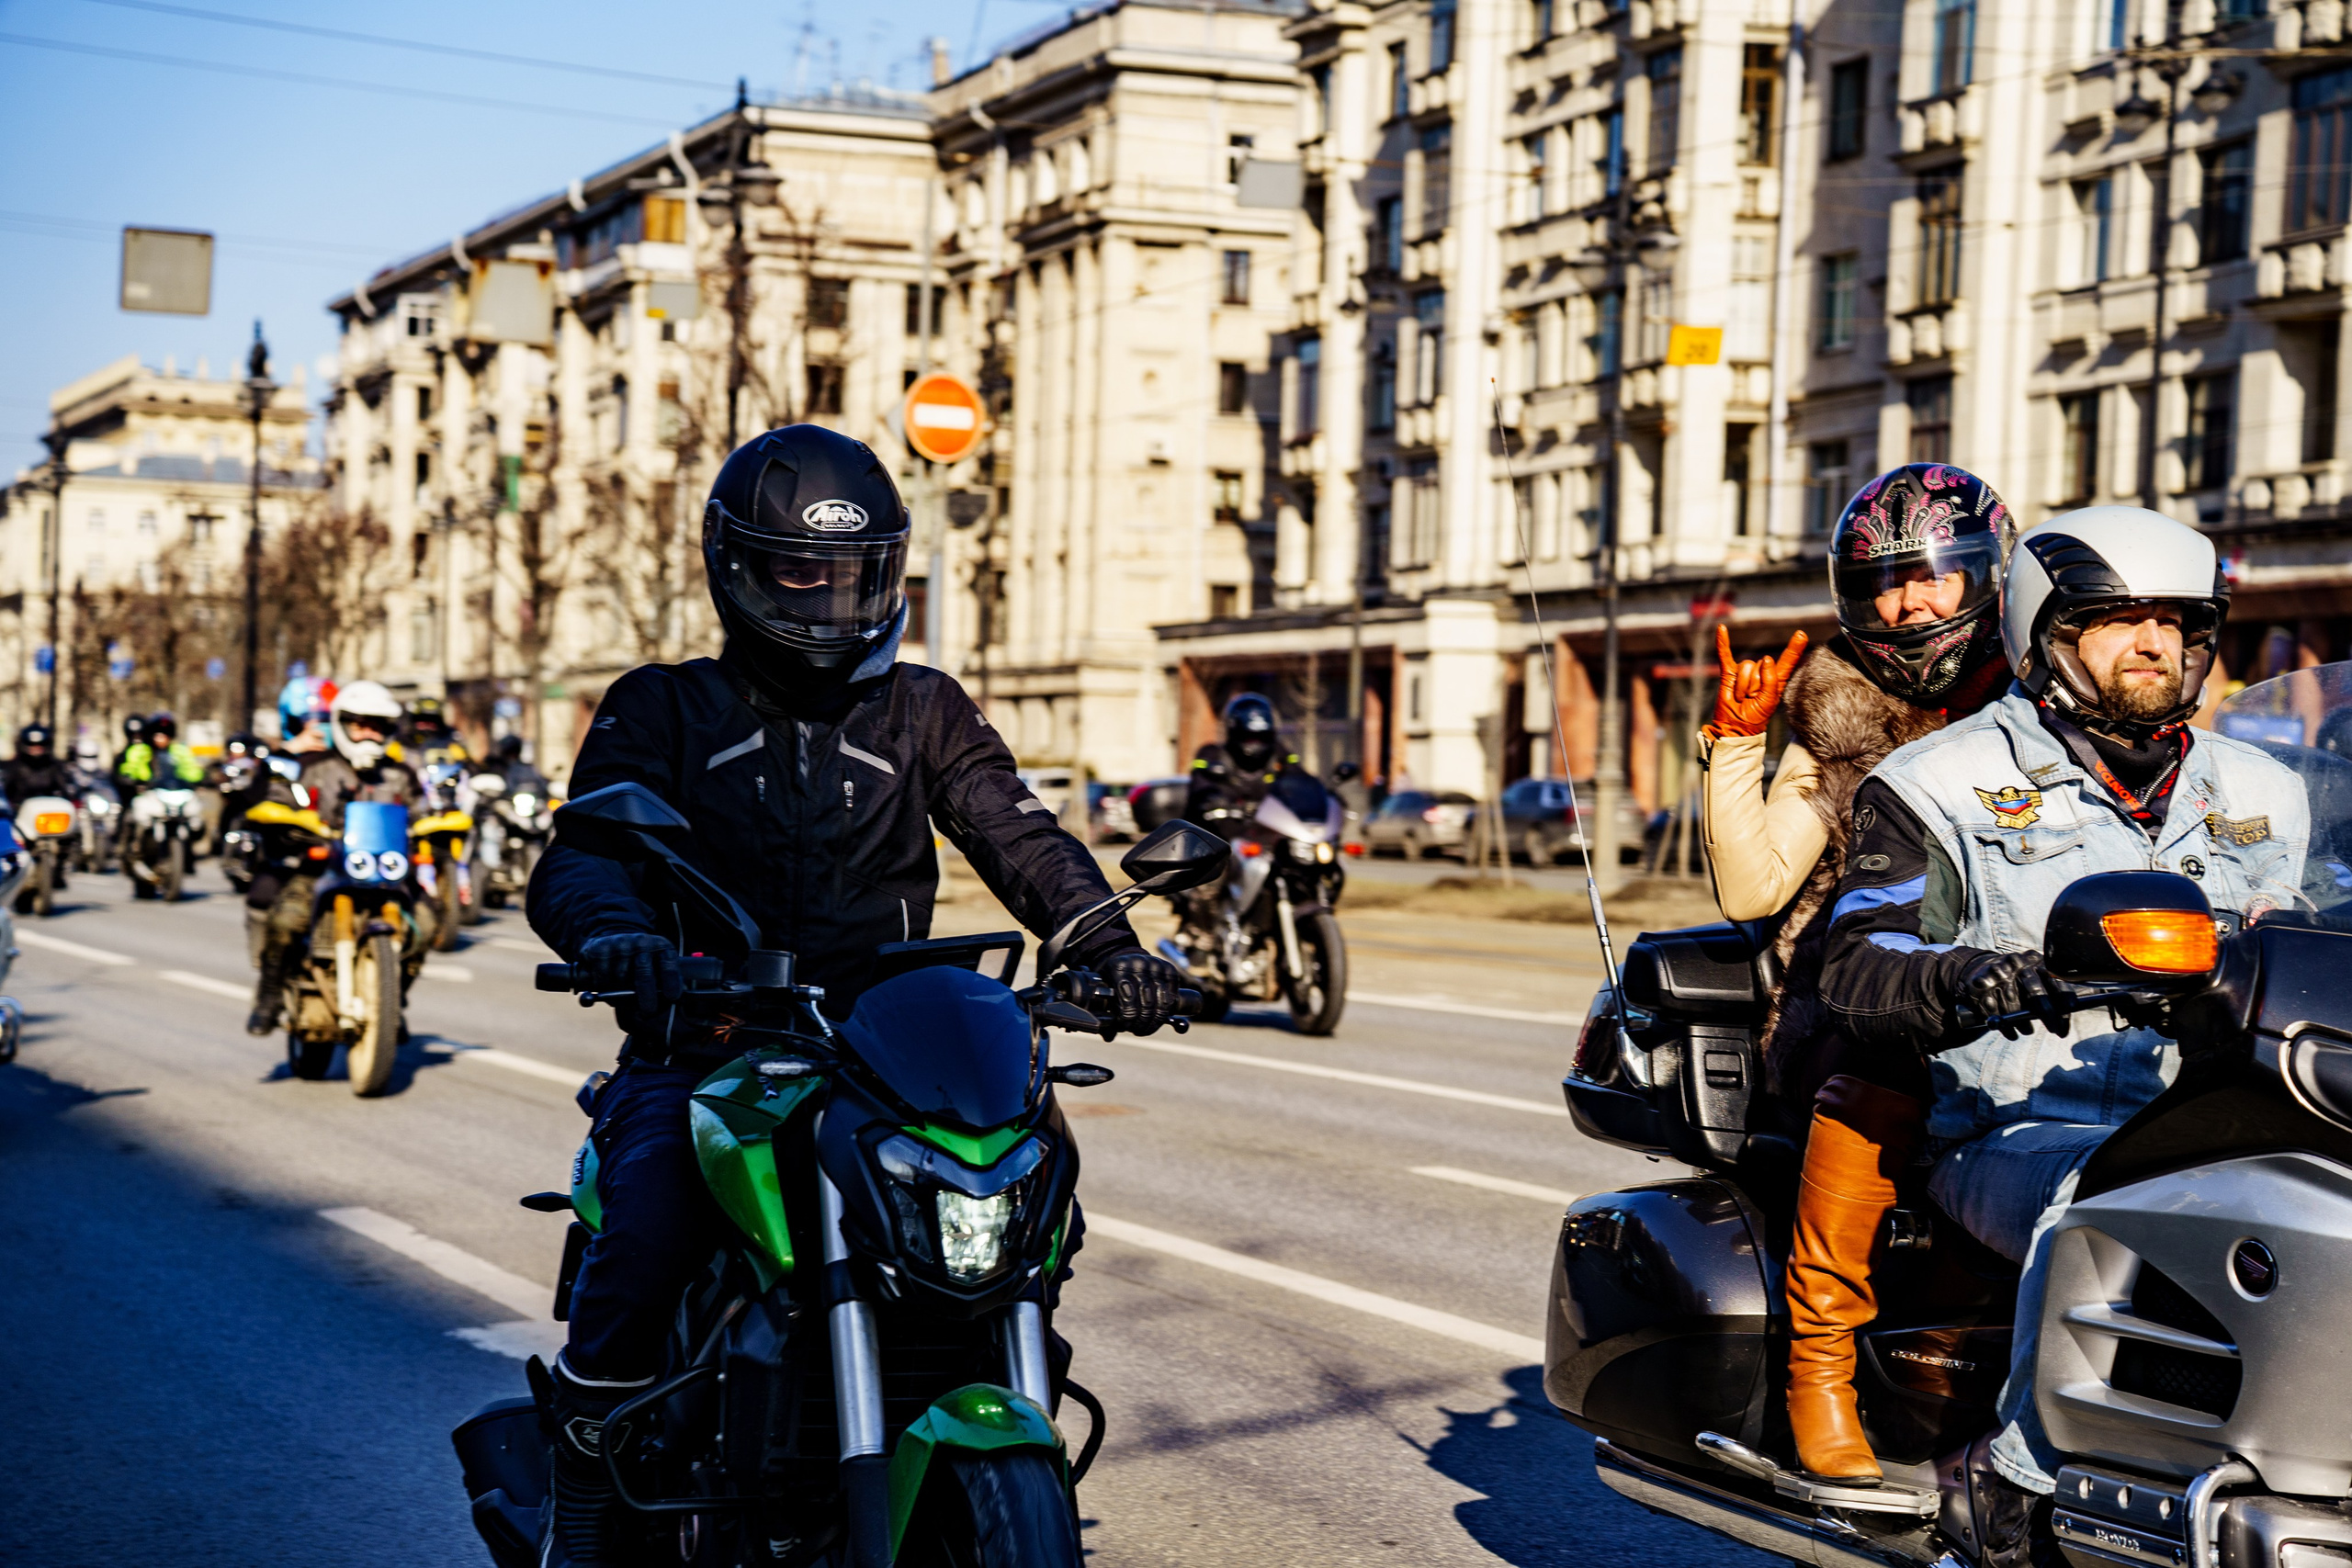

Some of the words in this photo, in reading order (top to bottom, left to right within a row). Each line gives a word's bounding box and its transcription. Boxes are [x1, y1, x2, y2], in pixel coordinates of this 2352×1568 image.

[810, 505, 863, 523] Airoh
[1869, 537, 1928, 558] SHARK
[2095, 760, 2143, 811] HONDA
[2095, 1529, 2141, 1552] HONDA
